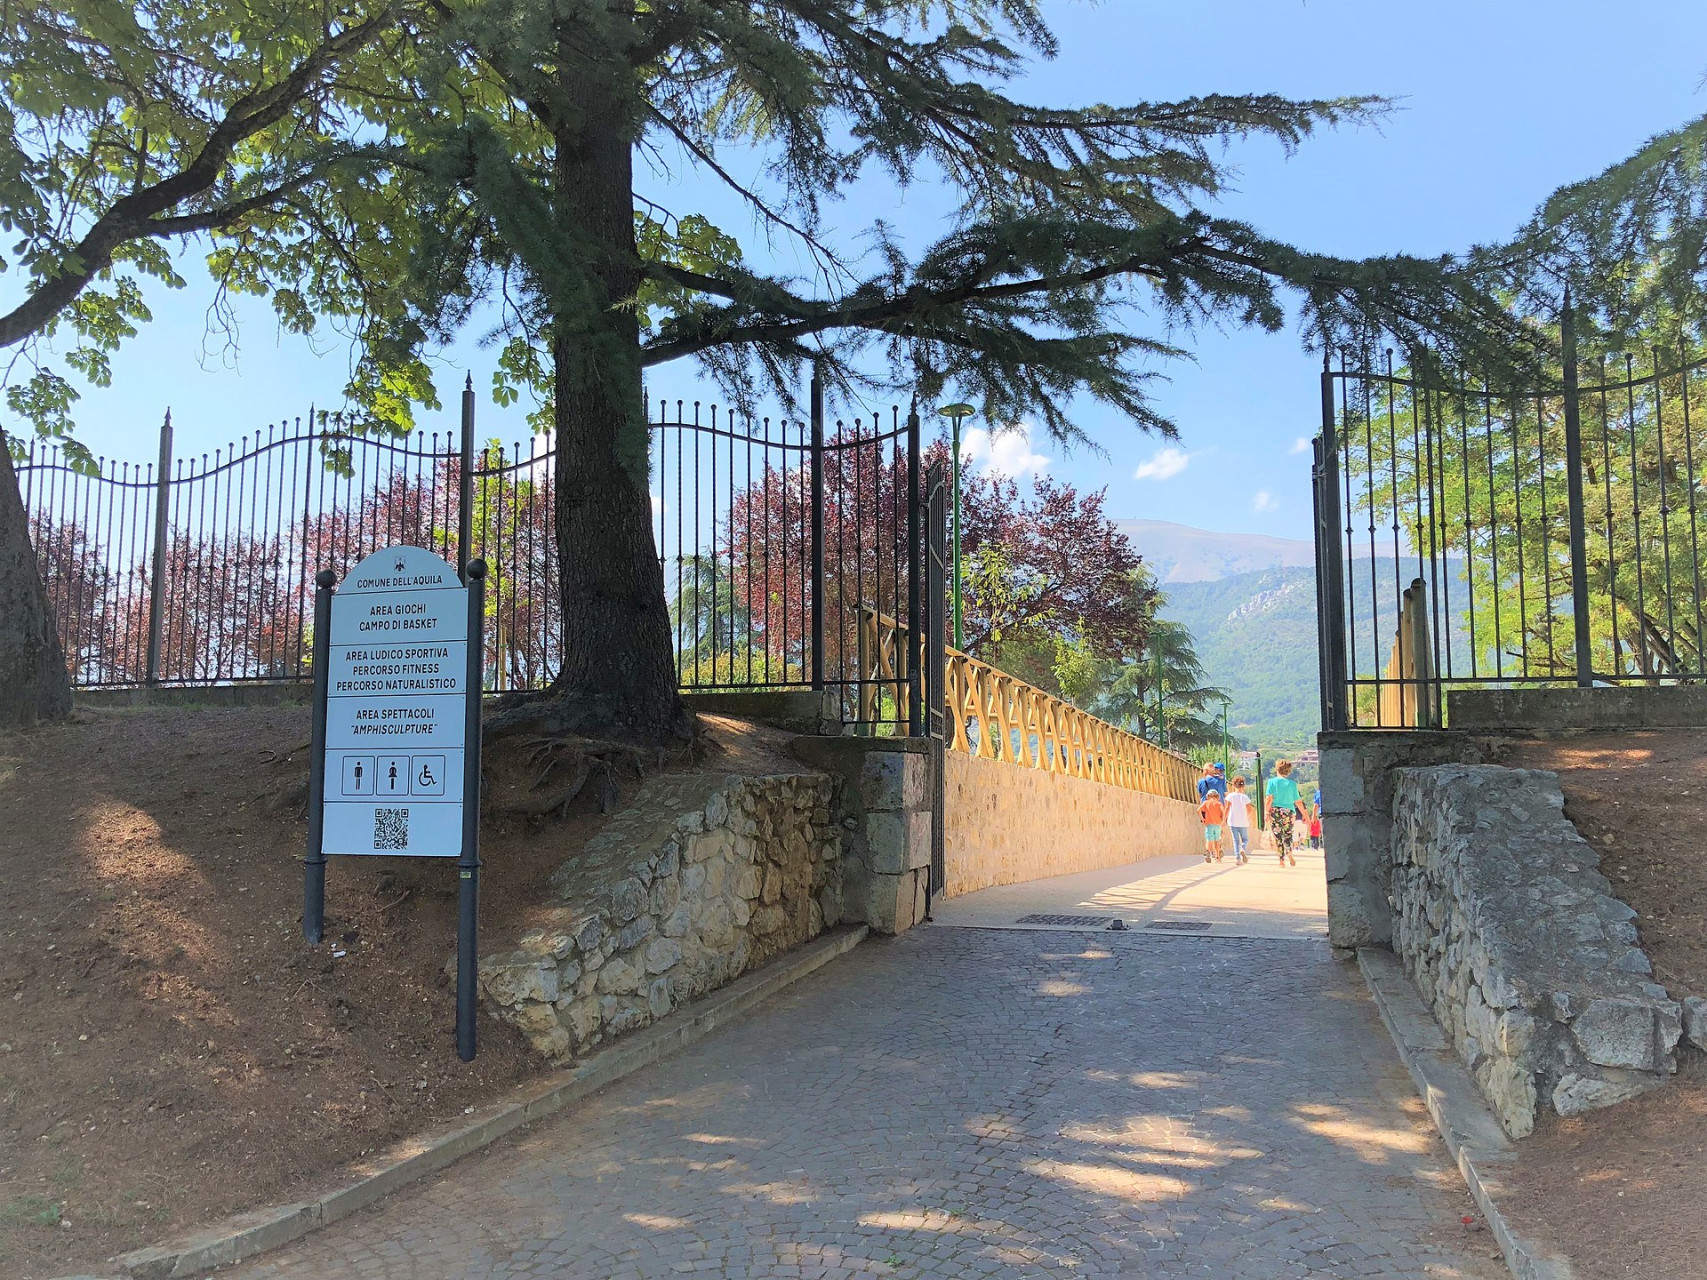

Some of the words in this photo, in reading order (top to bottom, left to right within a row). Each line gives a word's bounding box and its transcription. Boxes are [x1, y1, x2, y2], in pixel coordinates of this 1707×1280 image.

[357, 578, 390, 589] COMUNE
[392, 575, 442, 586] DELL'AQUILA
[370, 606, 393, 616] AREA
[395, 604, 426, 615] GIOCHI
[359, 620, 390, 631] CAMPO
[392, 620, 401, 630] DI
[403, 618, 437, 629] BASKET
[345, 651, 368, 661] AREA
[370, 649, 403, 660] LUDICO
[405, 648, 448, 659] SPORTIVA
[353, 665, 400, 676] PERCORSO
[402, 663, 439, 674] FITNESS
[336, 680, 383, 691] PERCORSO
[385, 678, 456, 690] NATURALISTICO
[356, 709, 379, 720] AREA
[381, 708, 434, 719] SPETTACOLI
